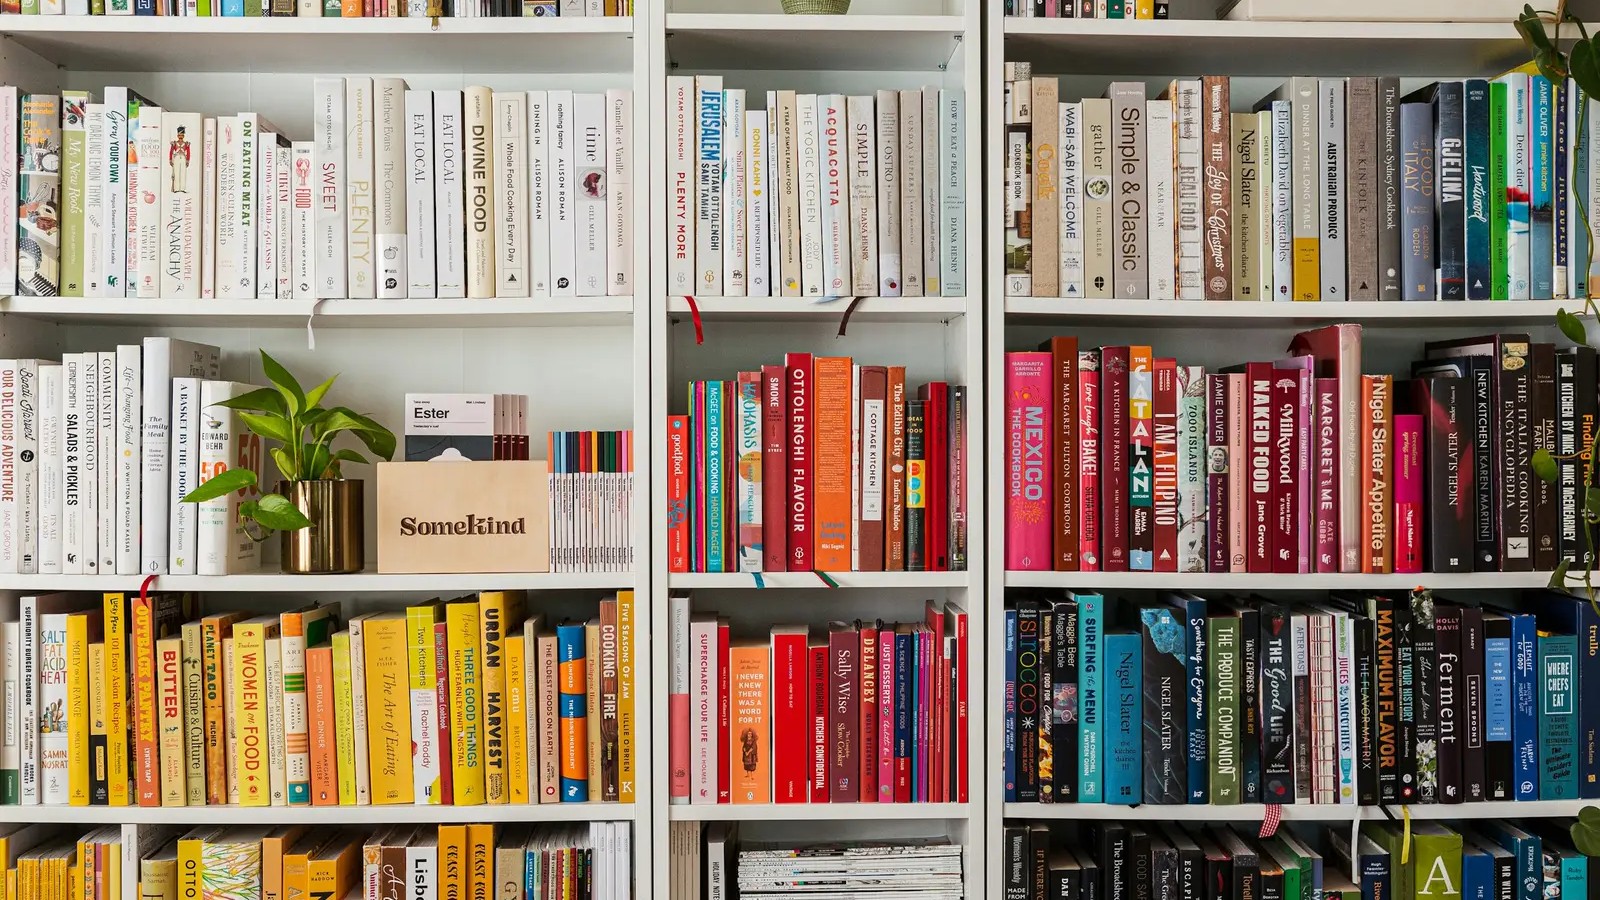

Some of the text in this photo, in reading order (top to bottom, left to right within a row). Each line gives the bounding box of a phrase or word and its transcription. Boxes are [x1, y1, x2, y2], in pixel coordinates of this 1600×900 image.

[69, 139, 81, 156] My
[106, 111, 125, 183] Grow YOUR OWN
[414, 114, 425, 184] EAT LOCAL
[557, 131, 565, 149] fancy
[585, 126, 600, 161] time
[615, 99, 623, 134] Cannelle
[701, 90, 720, 160] JERUSALEM
[1091, 125, 1105, 169] gather
[1540, 107, 1548, 136] OLIVER
[70, 161, 81, 185] New
[242, 121, 251, 226] ON EATING MEAT
[322, 163, 336, 212] SWEET
[472, 126, 486, 232] DIVINE FOOD
[615, 148, 624, 174] Vanille
[826, 108, 839, 206] ACQUACOTTA
[1065, 108, 1075, 238] WABI-SABI WELCOME
[1237, 129, 1255, 208] Nigel Slater
[1385, 87, 1395, 229] The Broadsheet Sydney Cookbook
[1442, 138, 1461, 202] GJELINA
[1540, 142, 1548, 165] jamie's
[70, 188, 82, 214] Roots
[506, 143, 516, 262] Whole Food Cooking Every Day
[677, 173, 685, 259] PLENTY MORE
[701, 163, 709, 220] SAMI TAMIMI
[710, 164, 719, 250] YOTAM OTTOLENGHI
[1118, 108, 1140, 270] Simple & Classic
[1206, 142, 1228, 271] THE Joy OF Christmas
[1469, 166, 1487, 222] Hartwood
[67, 414, 77, 452] SALADS
[86, 364, 94, 470] NEIGHBOURHOOD
[414, 408, 449, 419] Ester
[710, 388, 718, 413] McGEE
[710, 416, 717, 424] on
[893, 384, 903, 457] The Edible City
[1477, 373, 1488, 447] NEW KITCHEN
[1562, 383, 1574, 454] KITCHEN BY MIKE
[2, 370, 14, 502] OUR DELICIOUS ADVENTURE
[710, 427, 718, 448] FOOD
[793, 369, 804, 532] OTTOLENGHI FLAVOUR
[1012, 408, 1020, 496] THE COOKBOOK
[1025, 407, 1042, 500] MEXICO
[1188, 405, 1197, 482] 7000 ISLANDS
[1253, 380, 1269, 493] NAKED FOOD
[1277, 404, 1294, 484] Milkwood
[1369, 384, 1386, 549] Nigel Slater Appetite
[67, 466, 77, 505] PICKLES
[710, 458, 718, 493] COOKING
[1563, 465, 1575, 541] MIKE McENEARNEY
[400, 514, 526, 536] Somekind
[1257, 500, 1266, 558] Jane Grover
[1481, 494, 1489, 537] MARTINI
[41, 631, 66, 643] SALT
[42, 658, 66, 670] ACID
[45, 644, 63, 657] FAT
[111, 653, 119, 672] Easy
[864, 638, 874, 703] DELANCEY
[1086, 618, 1095, 724] SURFING MENU
[41, 671, 66, 684] HEAT
[112, 675, 120, 699] Asian
[163, 651, 177, 718] BUTTER
[242, 653, 259, 770] WOMEN on FOOD
[485, 609, 501, 768] URBAN HARVEST
[834, 650, 850, 713] Sally Wise
[1218, 628, 1236, 781] THE PRODUCE COMPANION
[1378, 610, 1394, 767] MAXIMUM FLAVOR
[1440, 653, 1457, 743] ferment
[112, 702, 121, 734] Recipes
[383, 673, 398, 776] The Art of Eating
